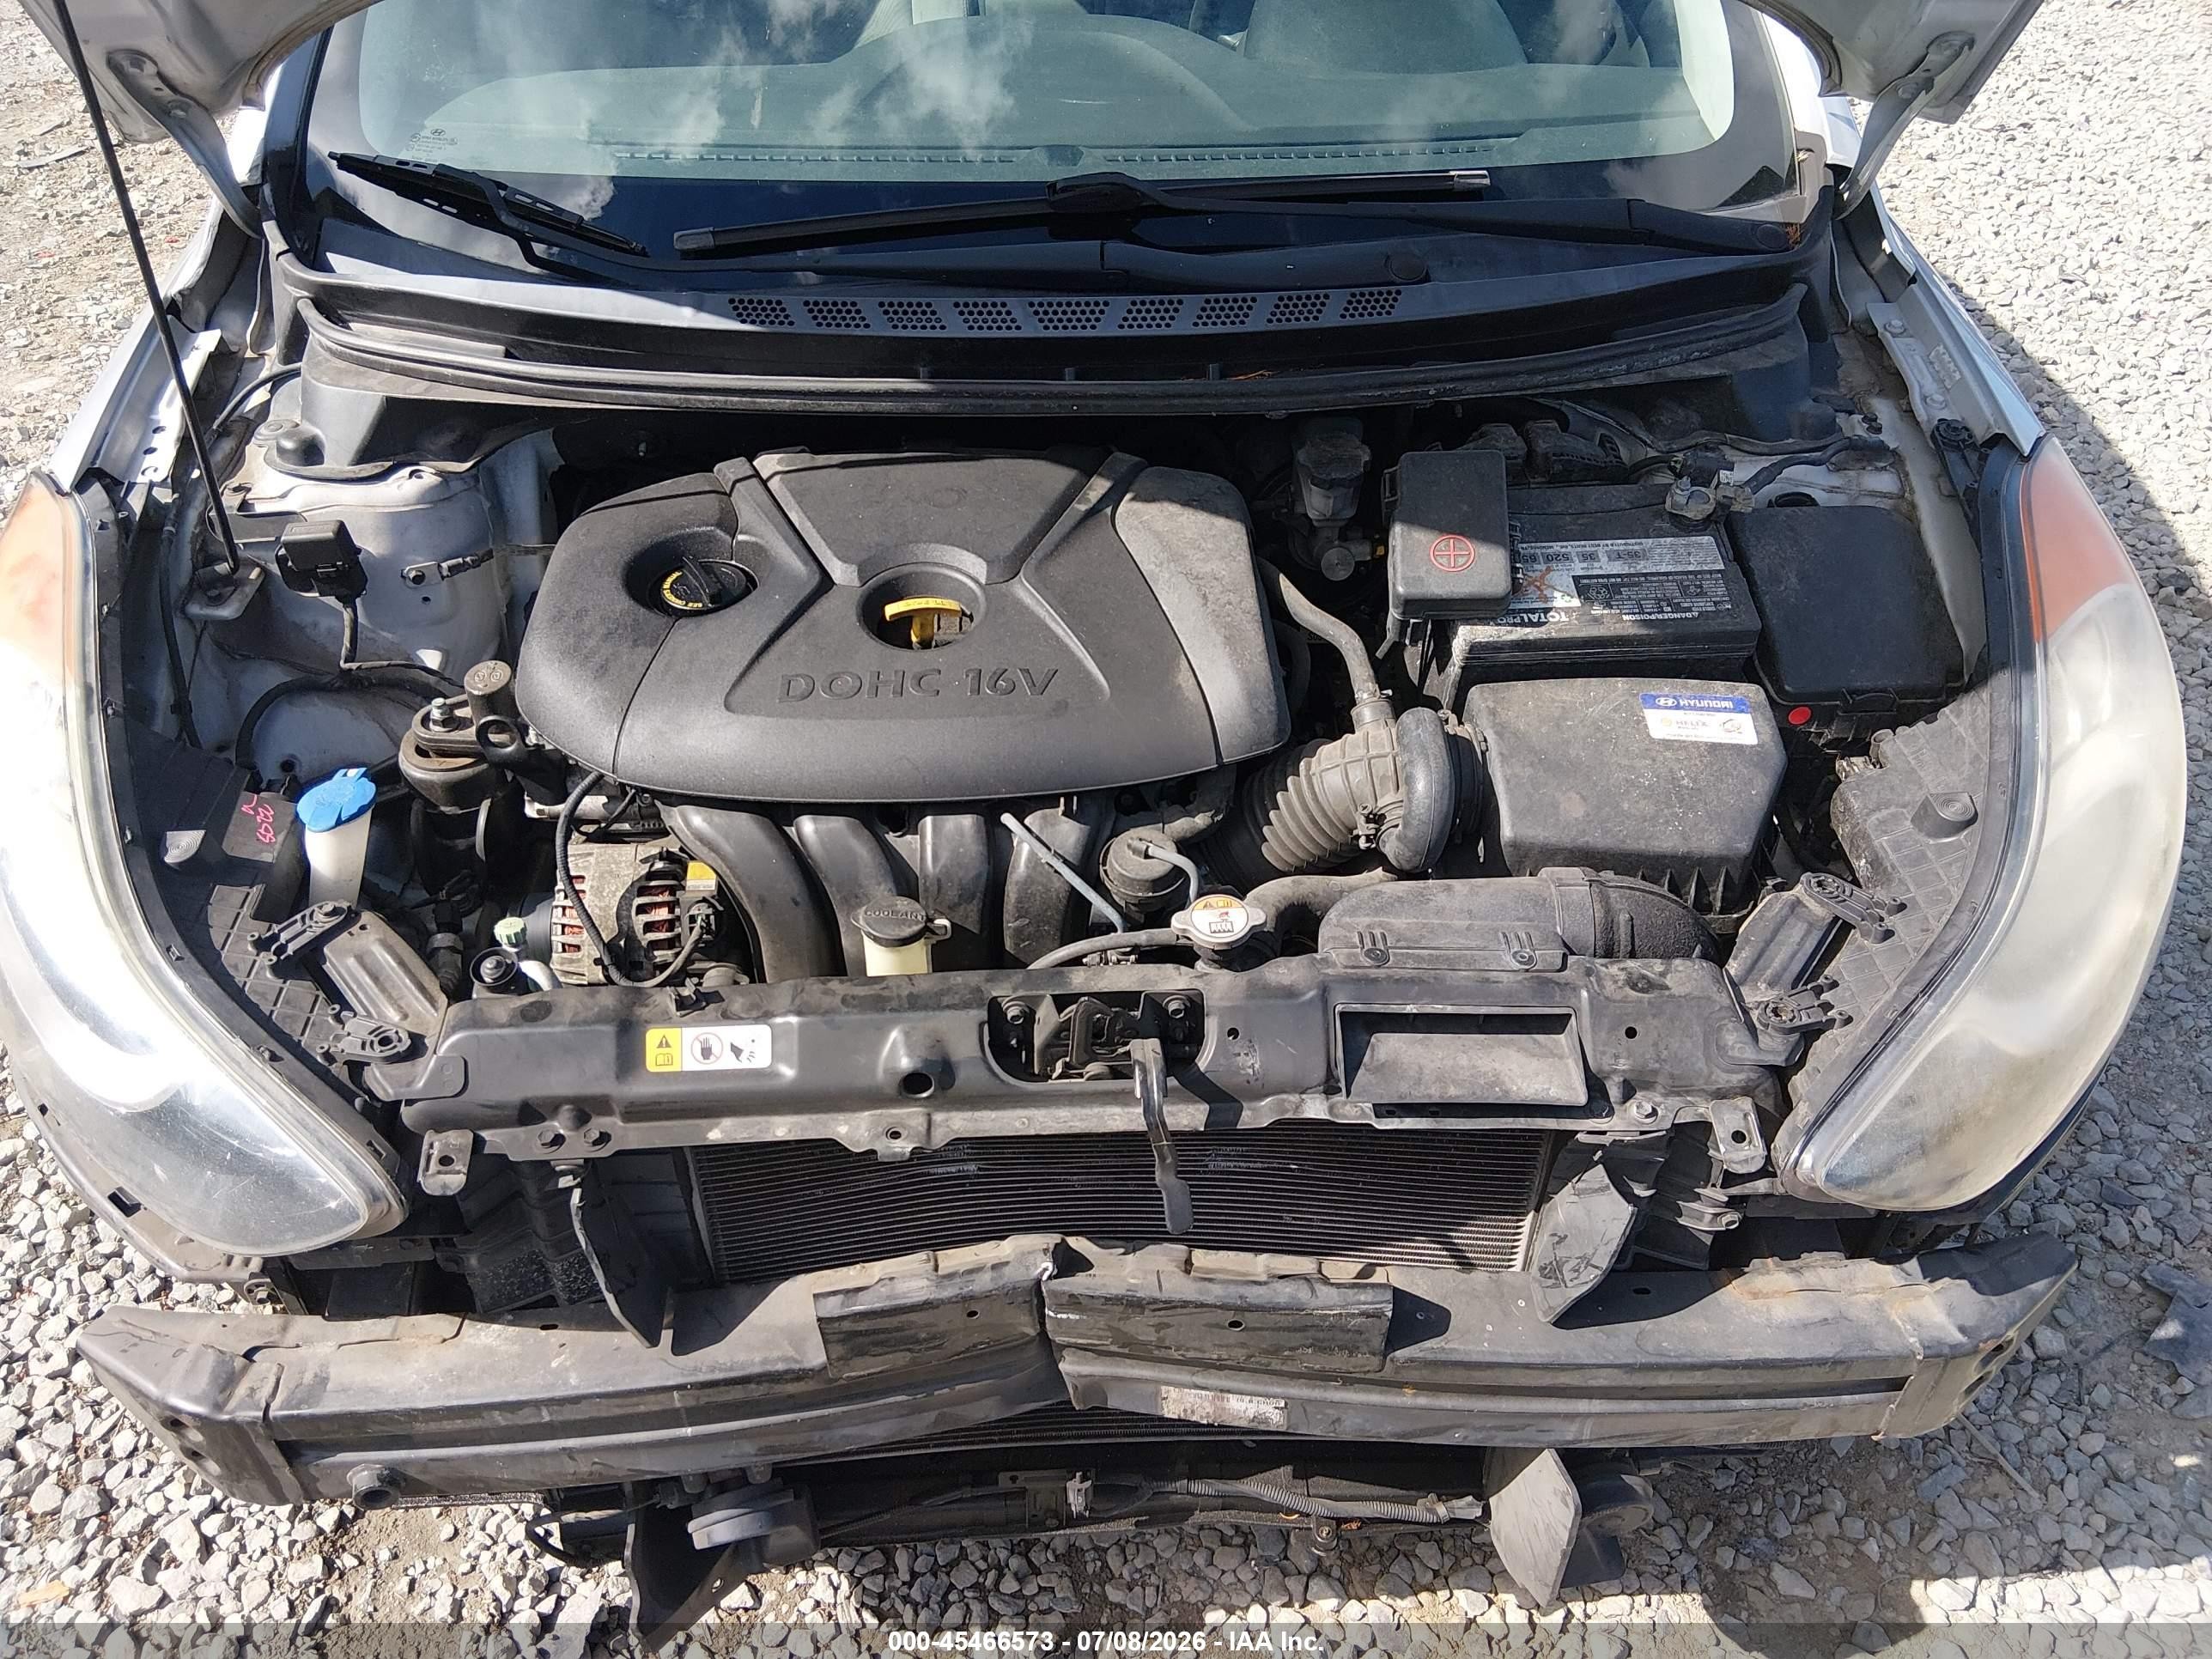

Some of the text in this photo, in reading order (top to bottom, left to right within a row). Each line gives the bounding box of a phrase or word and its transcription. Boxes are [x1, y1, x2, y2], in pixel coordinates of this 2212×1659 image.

[1547, 553, 1569, 562] 520
[1582, 552, 1595, 561] 35
[1615, 550, 1641, 560] 35-T
[1622, 611, 1692, 621] DANGER/POISON
[778, 666, 1060, 703] DOHC 16V
[1680, 698, 1733, 708] HYUNDAI
[865, 909, 926, 921] COOLANT
